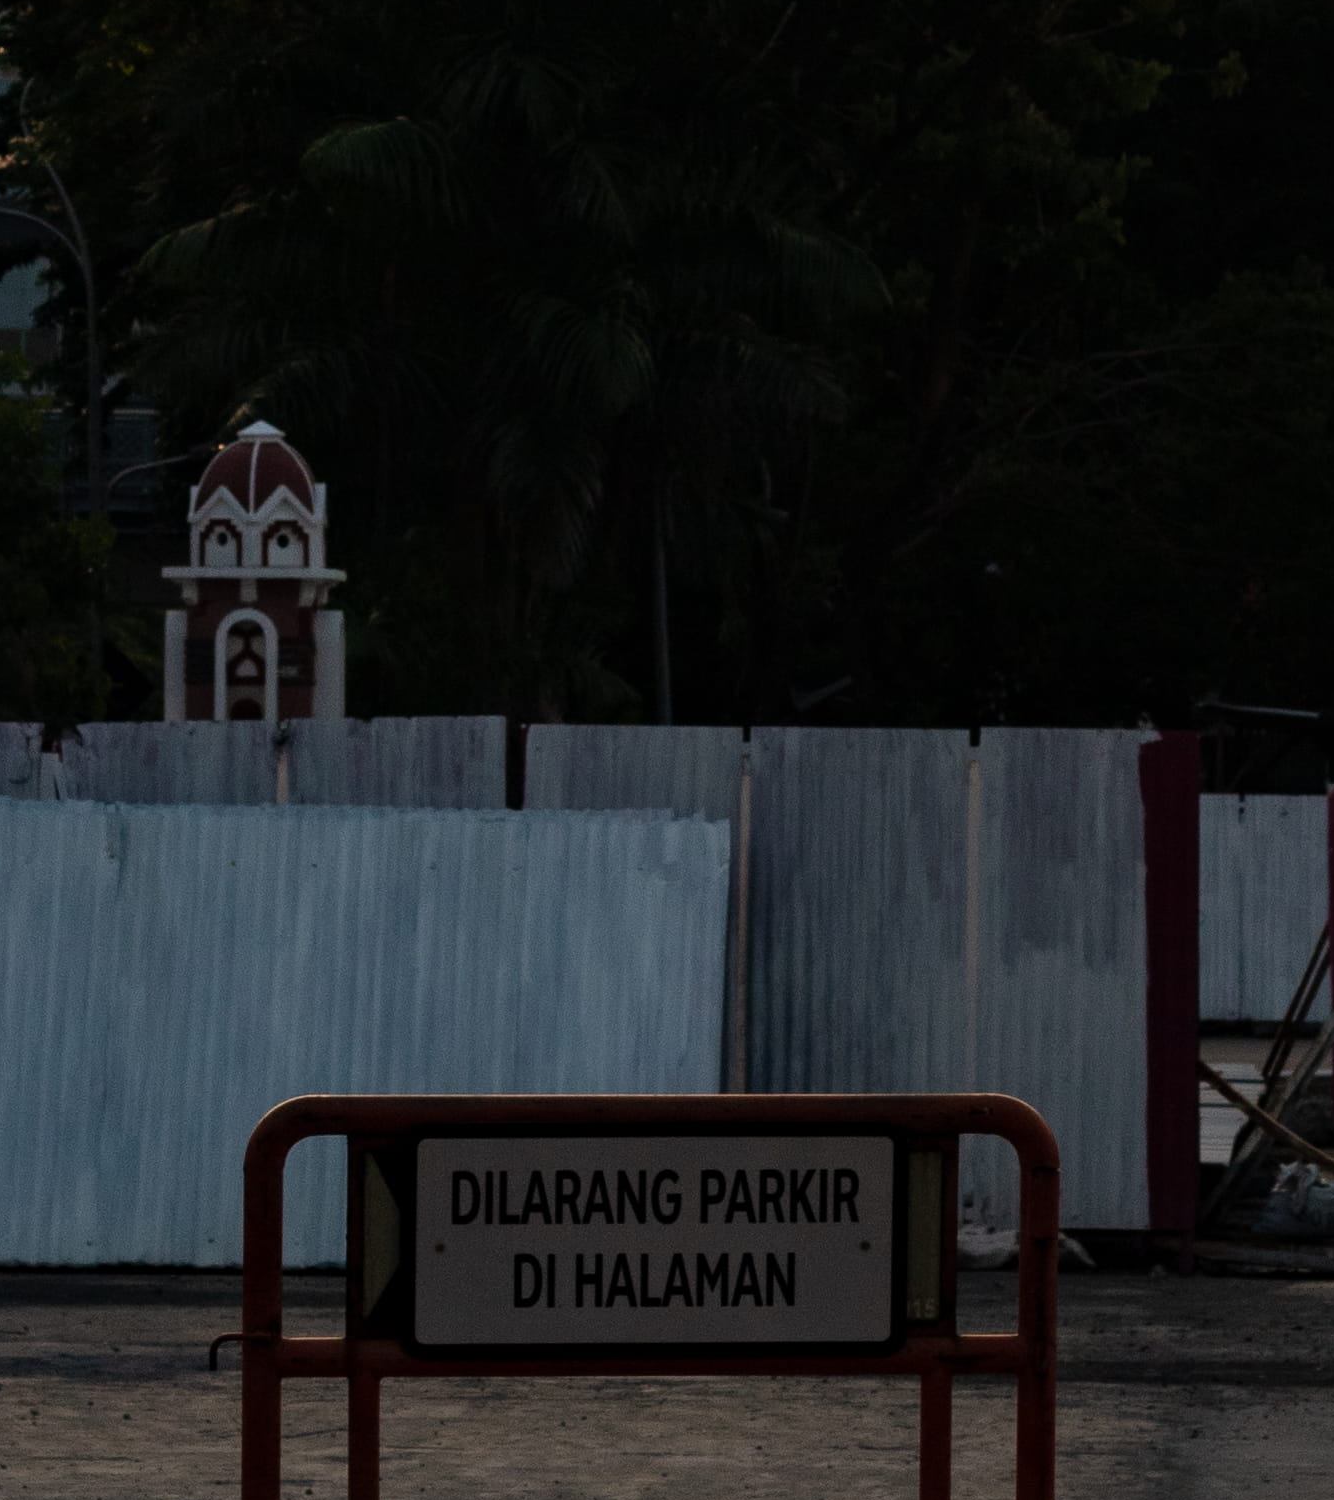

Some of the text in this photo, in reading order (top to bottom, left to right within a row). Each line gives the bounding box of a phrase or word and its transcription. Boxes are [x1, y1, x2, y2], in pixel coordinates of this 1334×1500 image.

[451, 1168, 860, 1226] DILARANG PARKIR
[513, 1252, 796, 1309] DI HALAMAN
